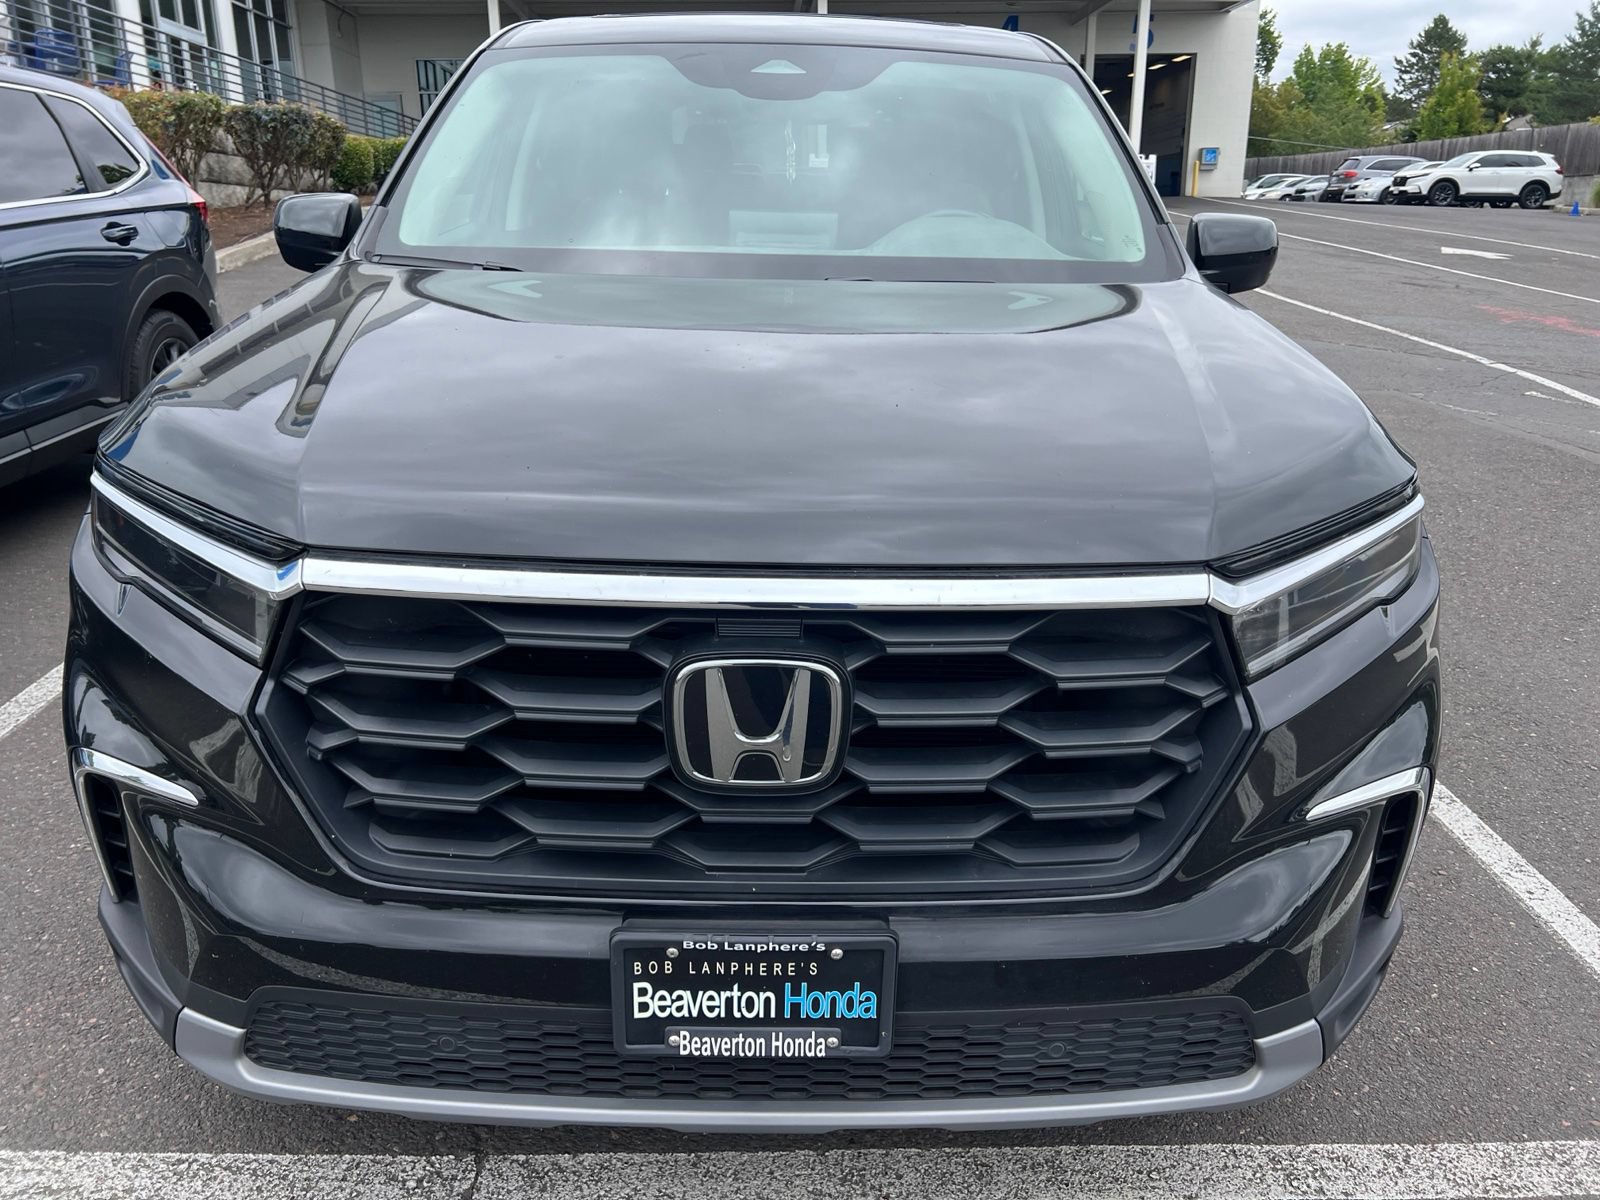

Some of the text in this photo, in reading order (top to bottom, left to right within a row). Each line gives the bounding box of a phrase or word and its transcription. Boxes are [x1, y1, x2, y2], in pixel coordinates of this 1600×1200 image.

[683, 940, 826, 953] Bob Lanphere's
[633, 961, 818, 976] BOB LANPHERE'S
[632, 982, 877, 1019] Beaverton Honda
[679, 1030, 826, 1057] Beaverton Honda
